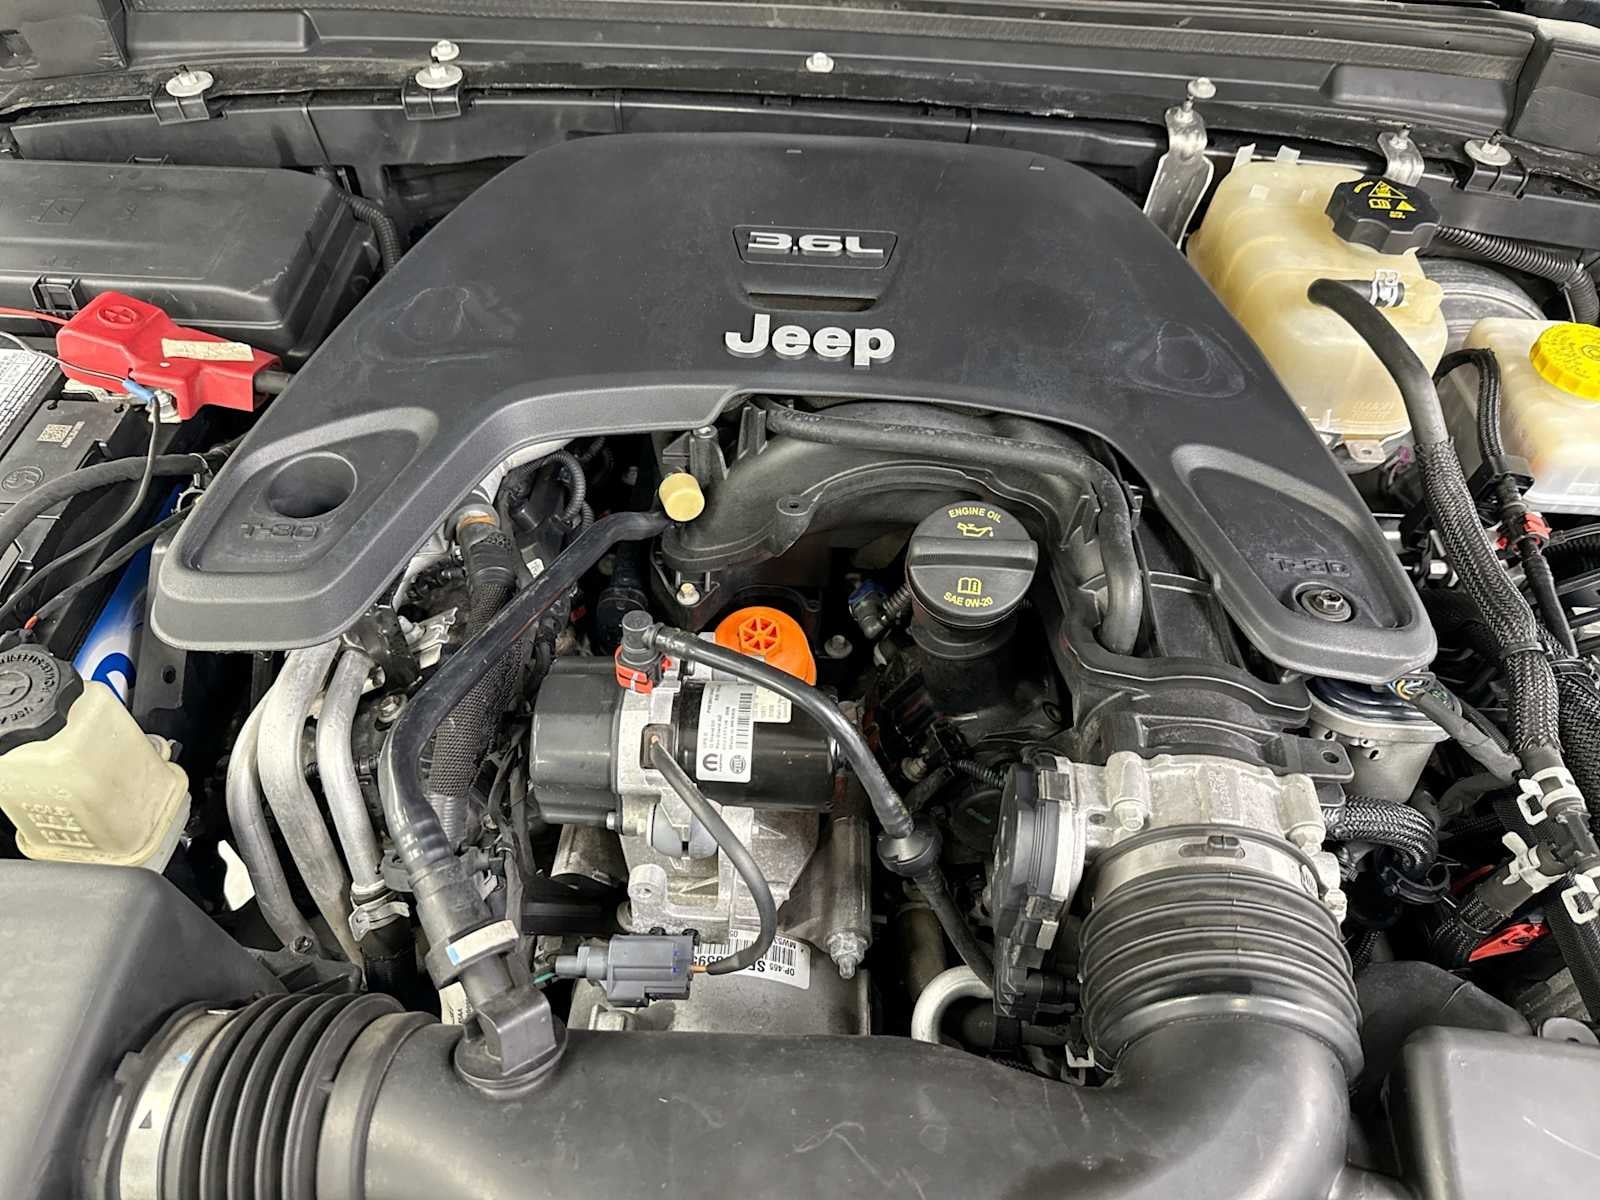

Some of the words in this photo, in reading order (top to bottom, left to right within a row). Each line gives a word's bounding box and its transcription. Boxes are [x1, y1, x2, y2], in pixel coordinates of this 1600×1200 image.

[748, 232, 884, 257] 3.6L
[725, 314, 896, 369] Jeep
[948, 507, 986, 518] ENGINE
[987, 511, 1001, 523] OIL
[943, 591, 963, 606] SAE
[964, 597, 993, 608] 0W-20
